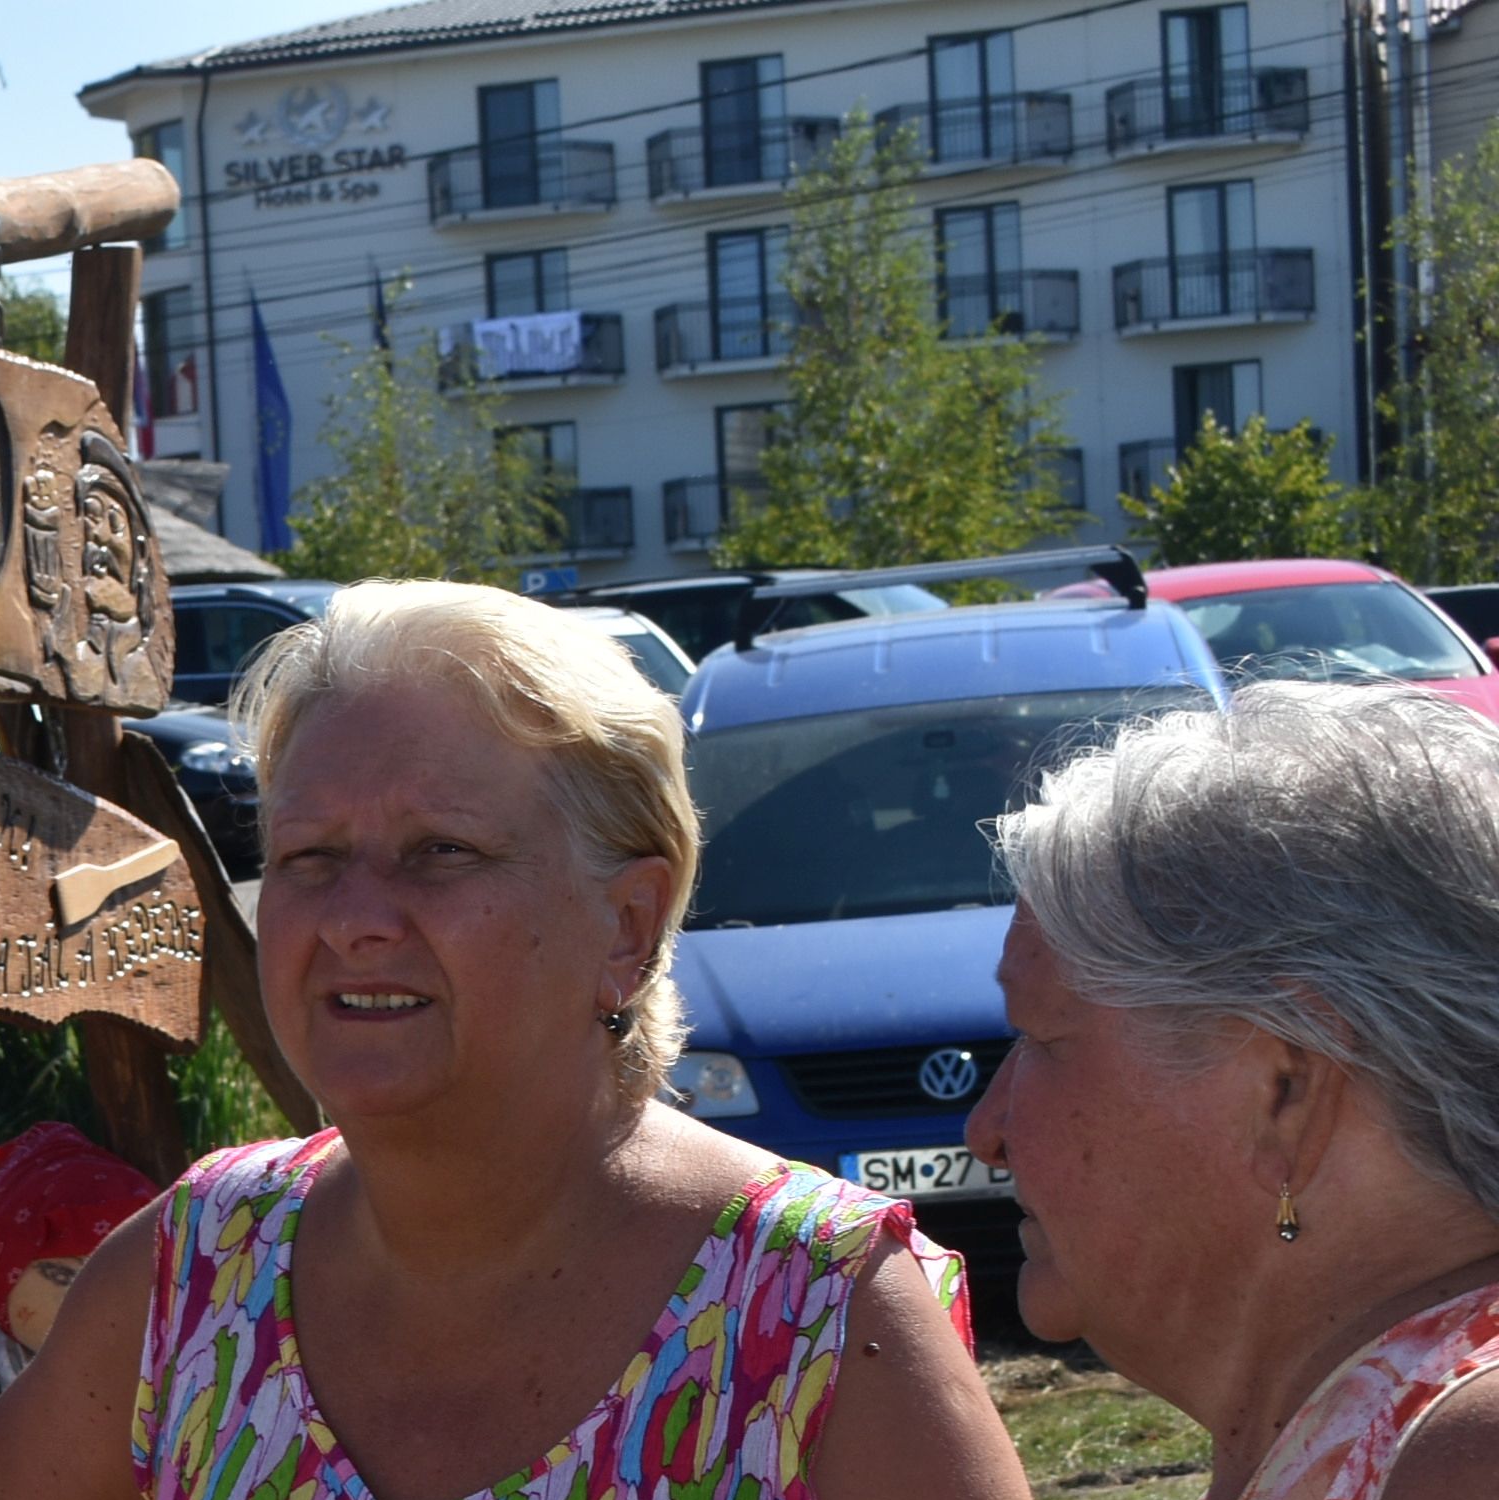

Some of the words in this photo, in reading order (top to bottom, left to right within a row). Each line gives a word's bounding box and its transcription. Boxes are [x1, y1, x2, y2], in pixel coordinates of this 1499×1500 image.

[224, 152, 324, 187] SILVER
[333, 144, 406, 171] STAR
[337, 176, 380, 202] Spa
